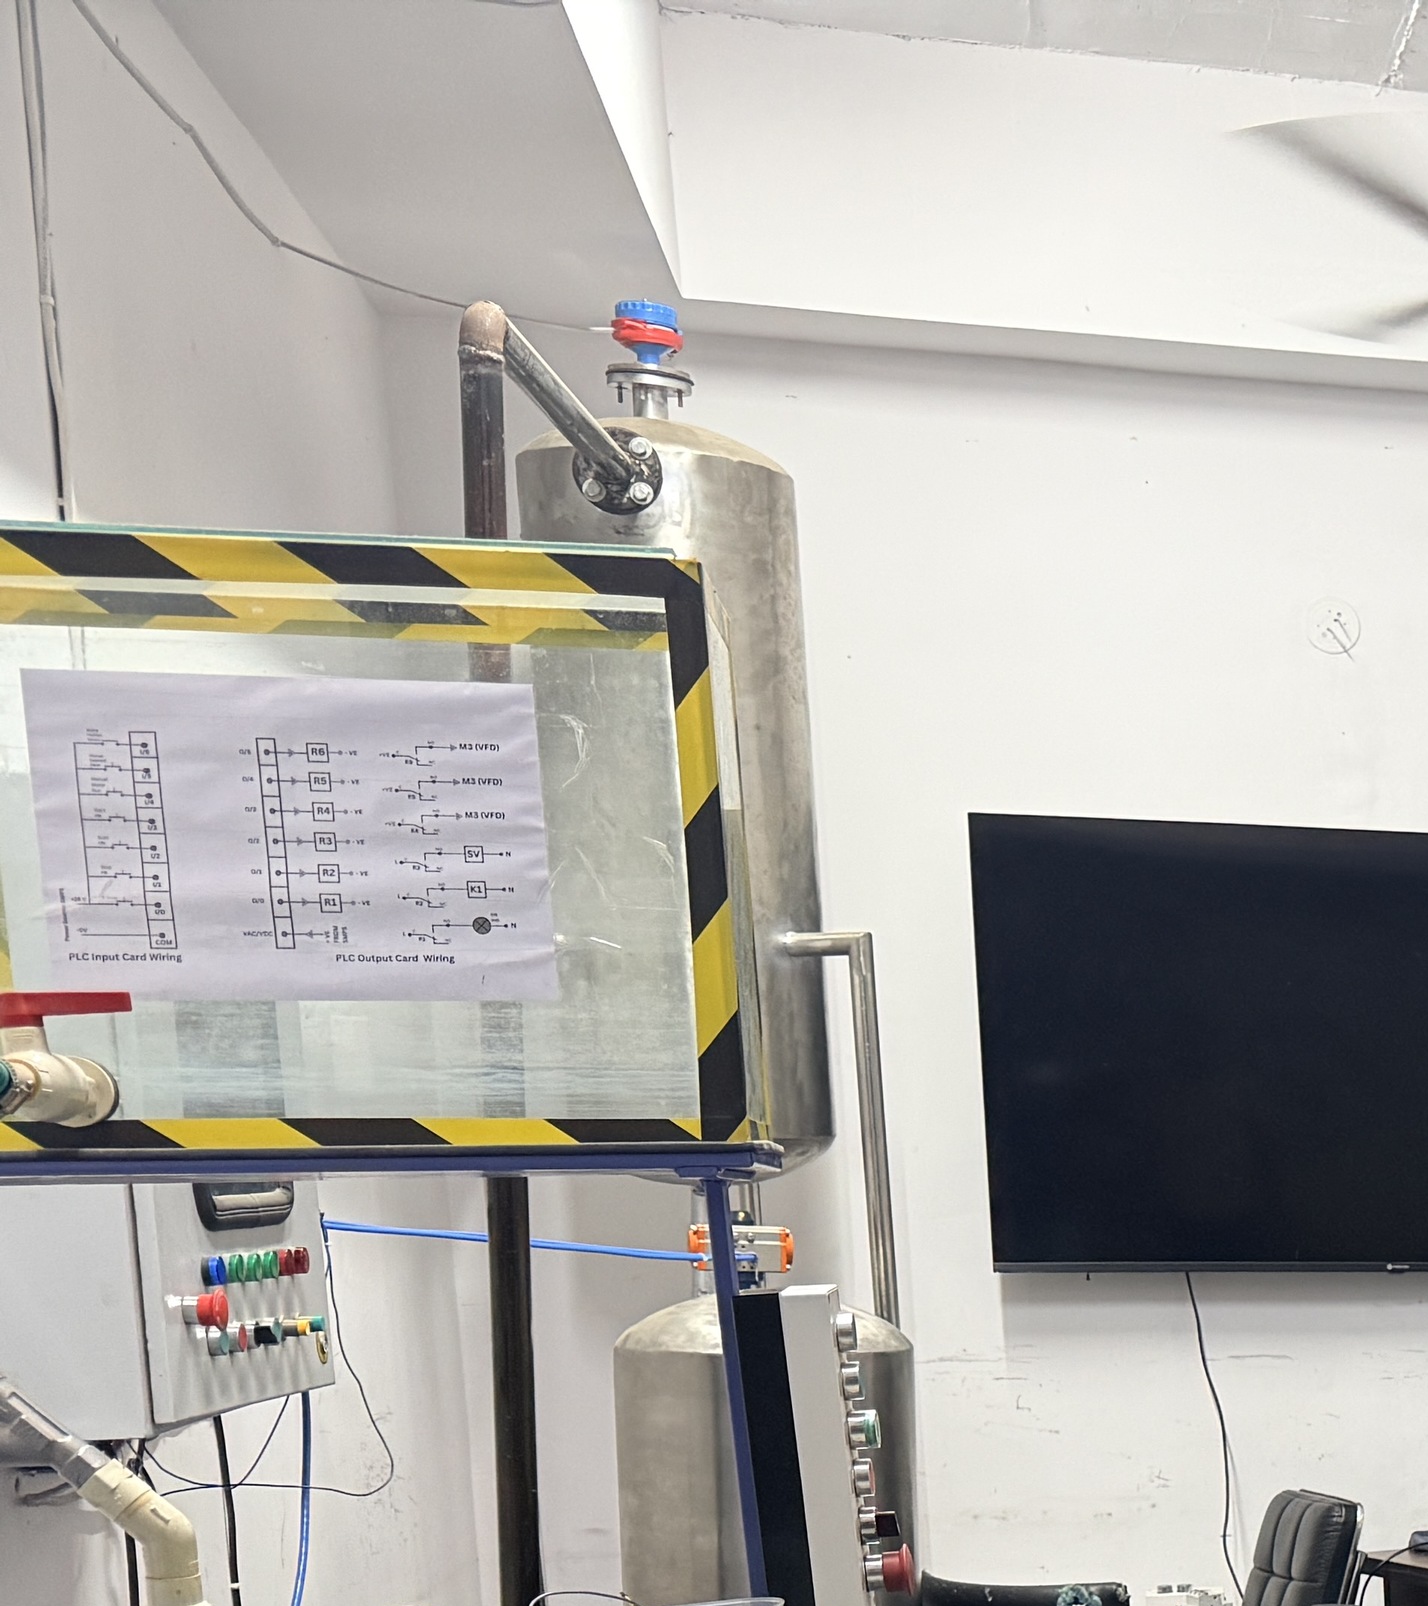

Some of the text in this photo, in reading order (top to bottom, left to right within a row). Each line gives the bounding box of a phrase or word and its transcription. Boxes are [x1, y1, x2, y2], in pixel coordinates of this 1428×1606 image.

[459, 743, 500, 752] M3 (VFD)
[311, 748, 325, 756] R6
[313, 777, 327, 785] R5
[462, 777, 503, 786] M3 (VFD)
[317, 807, 331, 815] R4
[464, 811, 505, 820] M3 (VFD)
[319, 837, 333, 845] R3
[467, 850, 480, 858] SV
[322, 869, 336, 877] R2
[324, 898, 337, 907] R1
[69, 953, 182, 963] PLC Input Card Wiring
[335, 954, 455, 964] PLC Output Card Wiring
